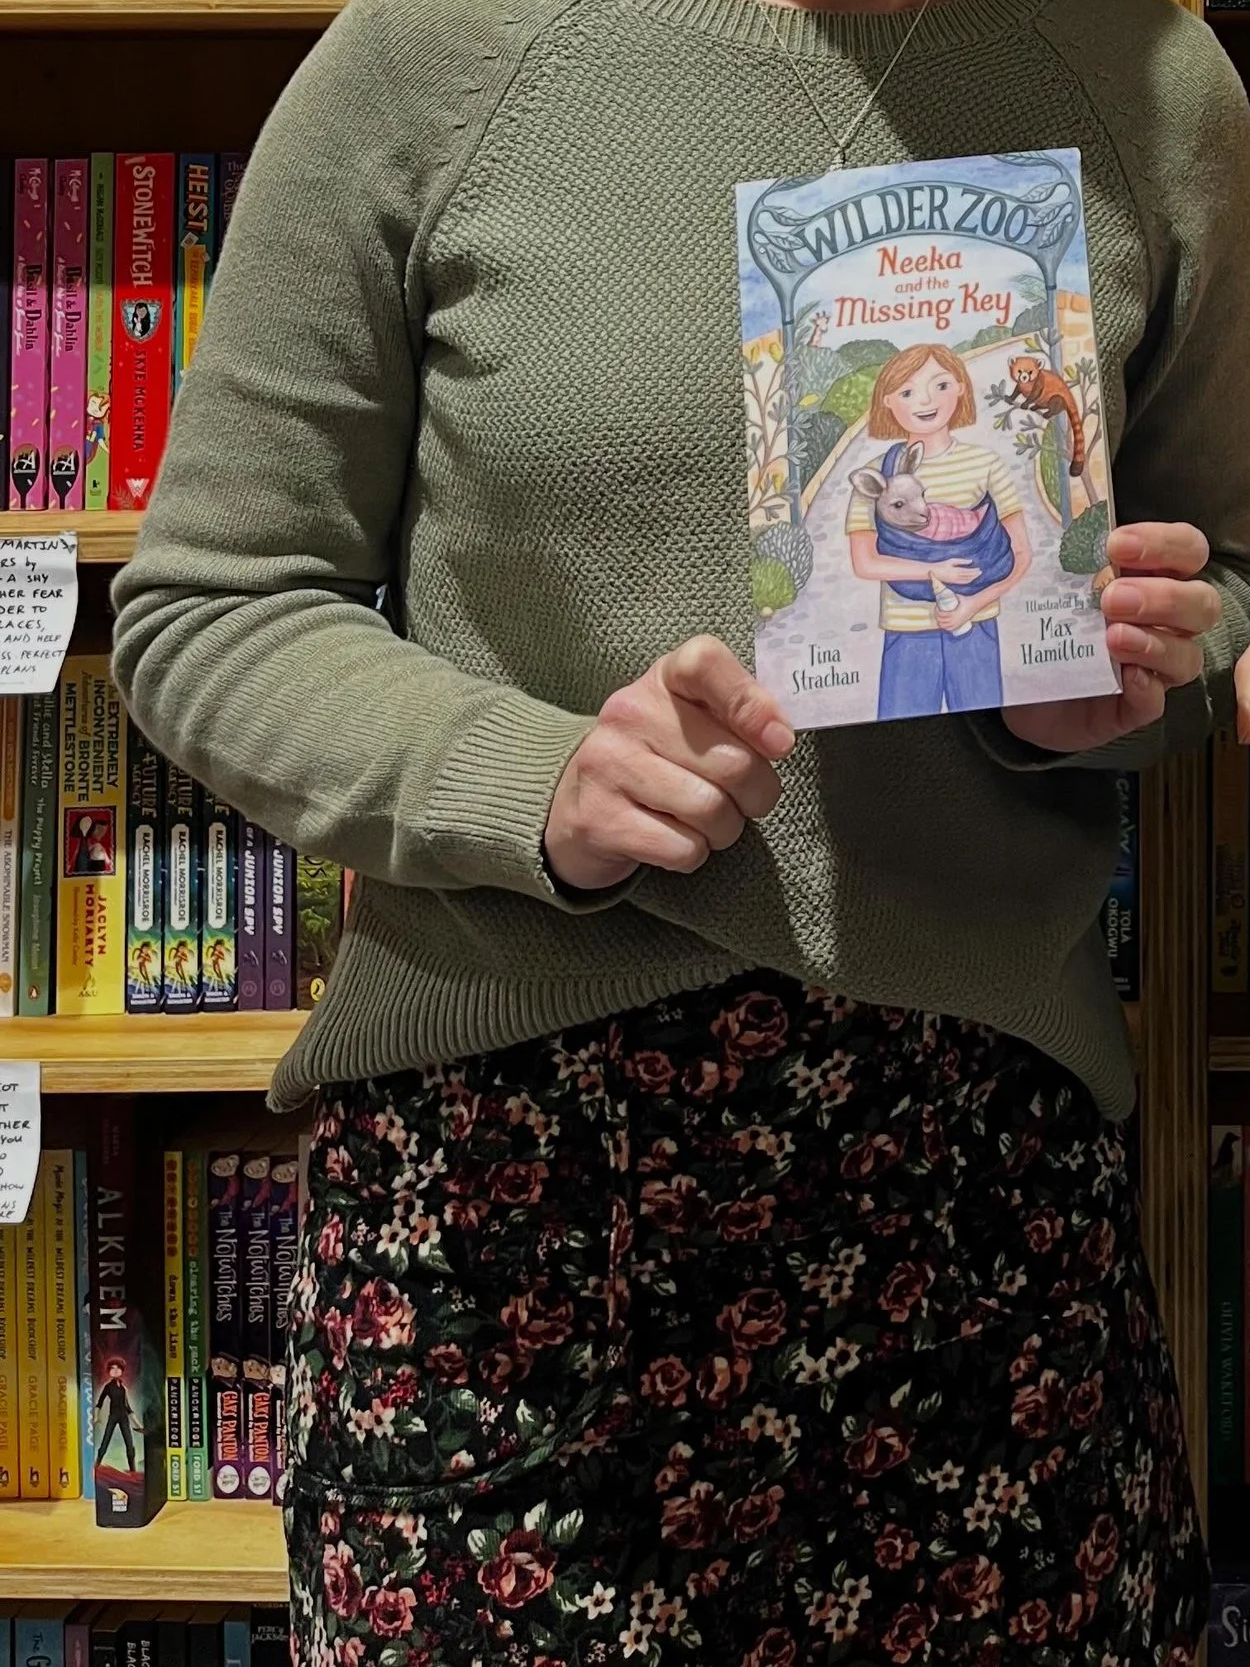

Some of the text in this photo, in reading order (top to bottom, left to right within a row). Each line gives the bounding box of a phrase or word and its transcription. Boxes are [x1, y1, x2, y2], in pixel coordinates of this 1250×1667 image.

[185, 164, 209, 232] HEIST
[132, 164, 155, 289] STONEWITCH
[800, 185, 1030, 263] WILDER ZOO
[878, 246, 963, 278] Neeka
[894, 275, 949, 294] and the
[835, 284, 1011, 330] Missing Key
[1025, 596, 1085, 614] Illustrated by
[1040, 617, 1073, 640] Max
[809, 644, 841, 663] Tina
[1020, 640, 1095, 665] Hamilton
[791, 667, 860, 694] Strachan
[85, 884, 95, 968] MORIARTY
[97, 895, 106, 955] JACLYN
[97, 1186, 127, 1331] ALKREM
